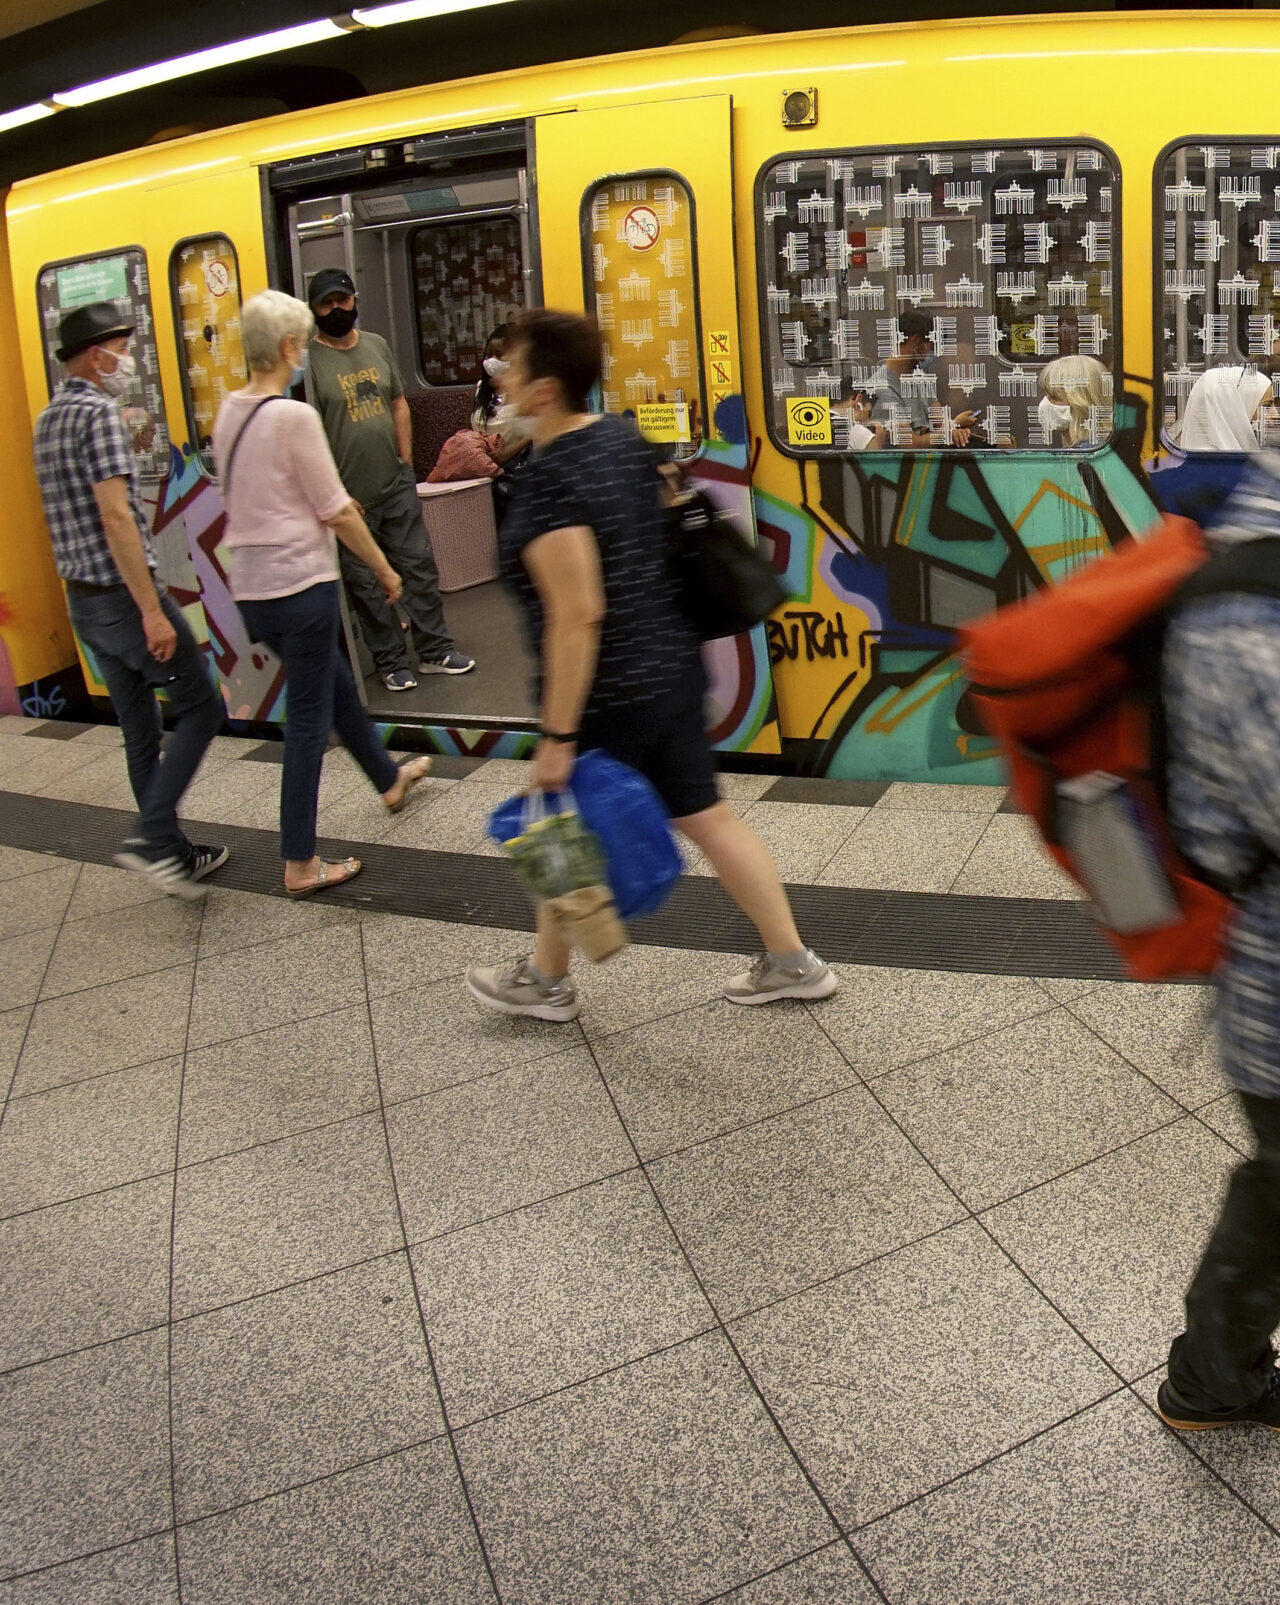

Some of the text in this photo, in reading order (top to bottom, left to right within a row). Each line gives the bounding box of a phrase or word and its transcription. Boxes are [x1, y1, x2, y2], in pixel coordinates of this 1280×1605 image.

[337, 367, 380, 390] keep
[639, 407, 674, 415] Beförderung
[795, 429, 826, 441] Video
[766, 611, 848, 665] BUTCH
